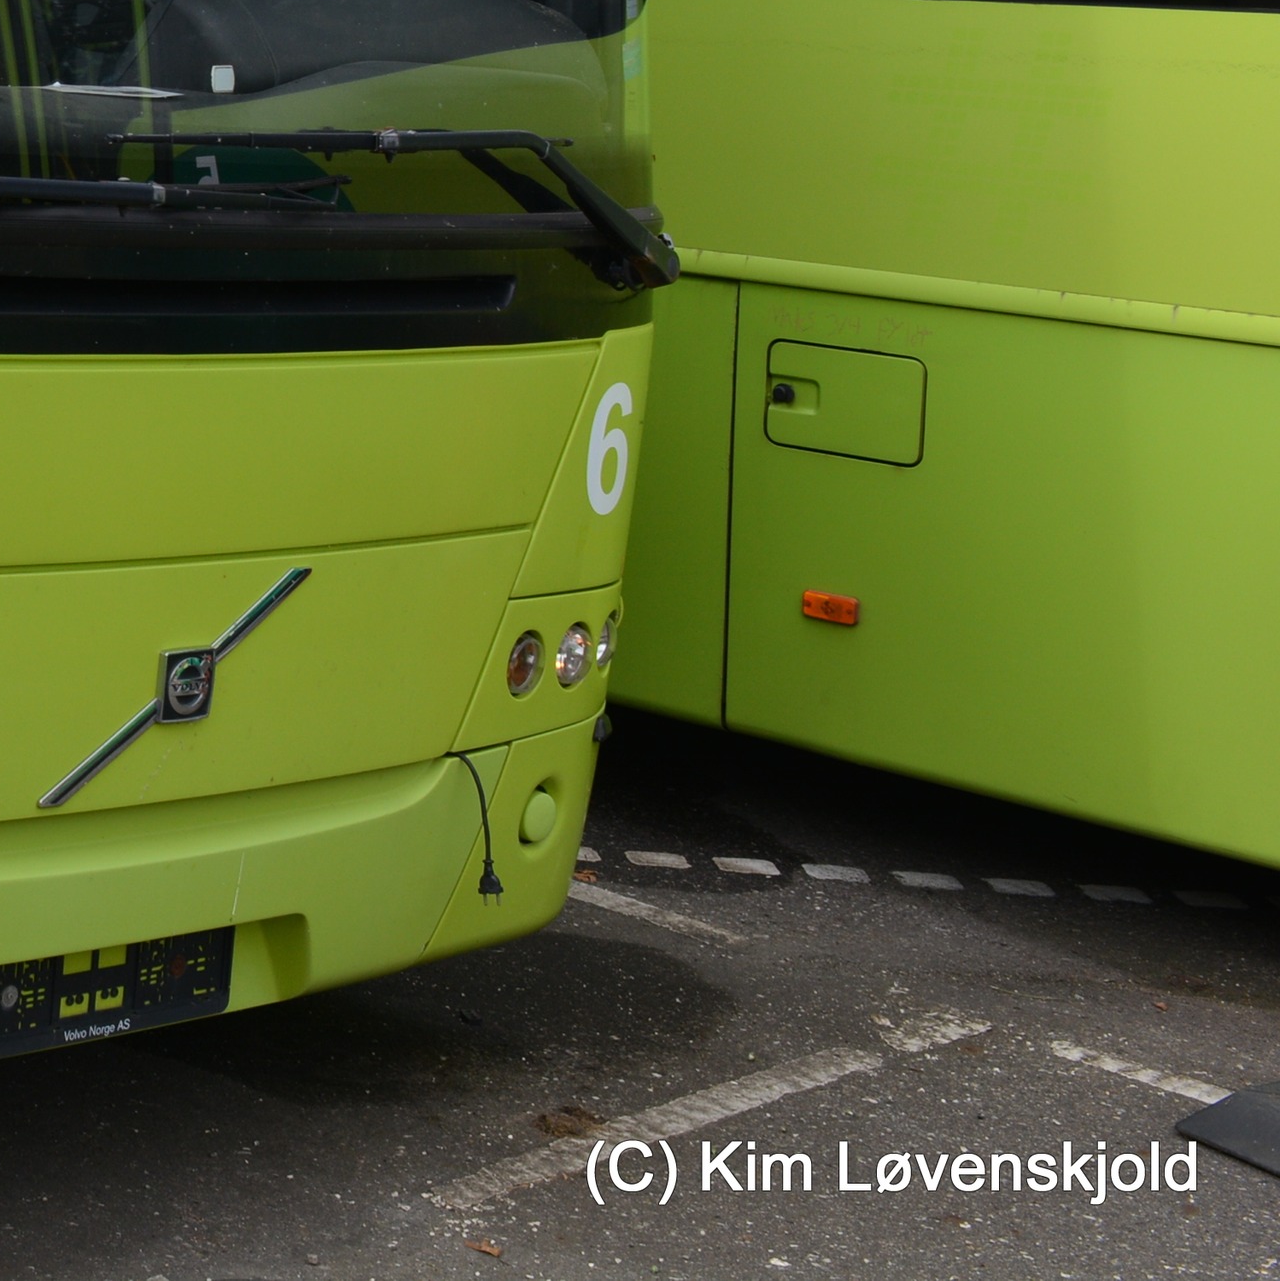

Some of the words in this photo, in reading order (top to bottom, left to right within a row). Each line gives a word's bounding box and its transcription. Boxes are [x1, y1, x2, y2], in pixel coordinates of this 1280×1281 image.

[586, 381, 634, 516] 6
[64, 1029, 87, 1041] Volvo
[89, 1024, 115, 1036] Norge
[117, 1018, 131, 1031] AS
